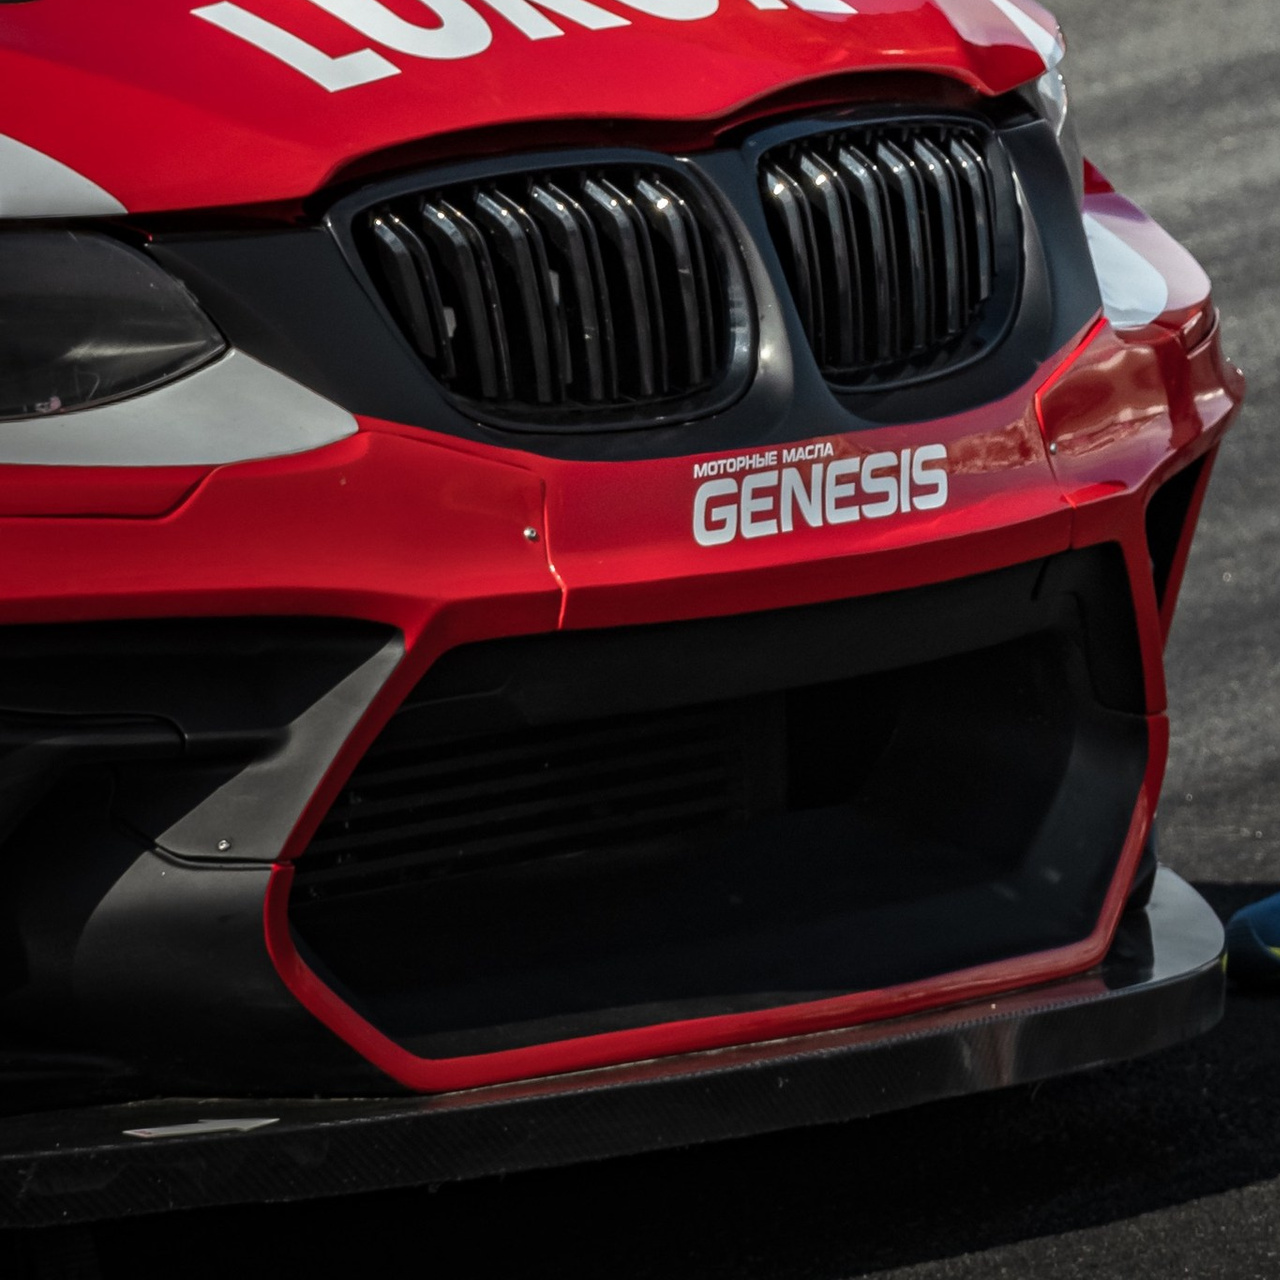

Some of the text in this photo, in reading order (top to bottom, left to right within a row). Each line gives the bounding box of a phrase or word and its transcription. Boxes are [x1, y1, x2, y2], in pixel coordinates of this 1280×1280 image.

[692, 443, 949, 548] GENESIS
[693, 442, 834, 479] МОТОРНЫЕ МАСЛА
